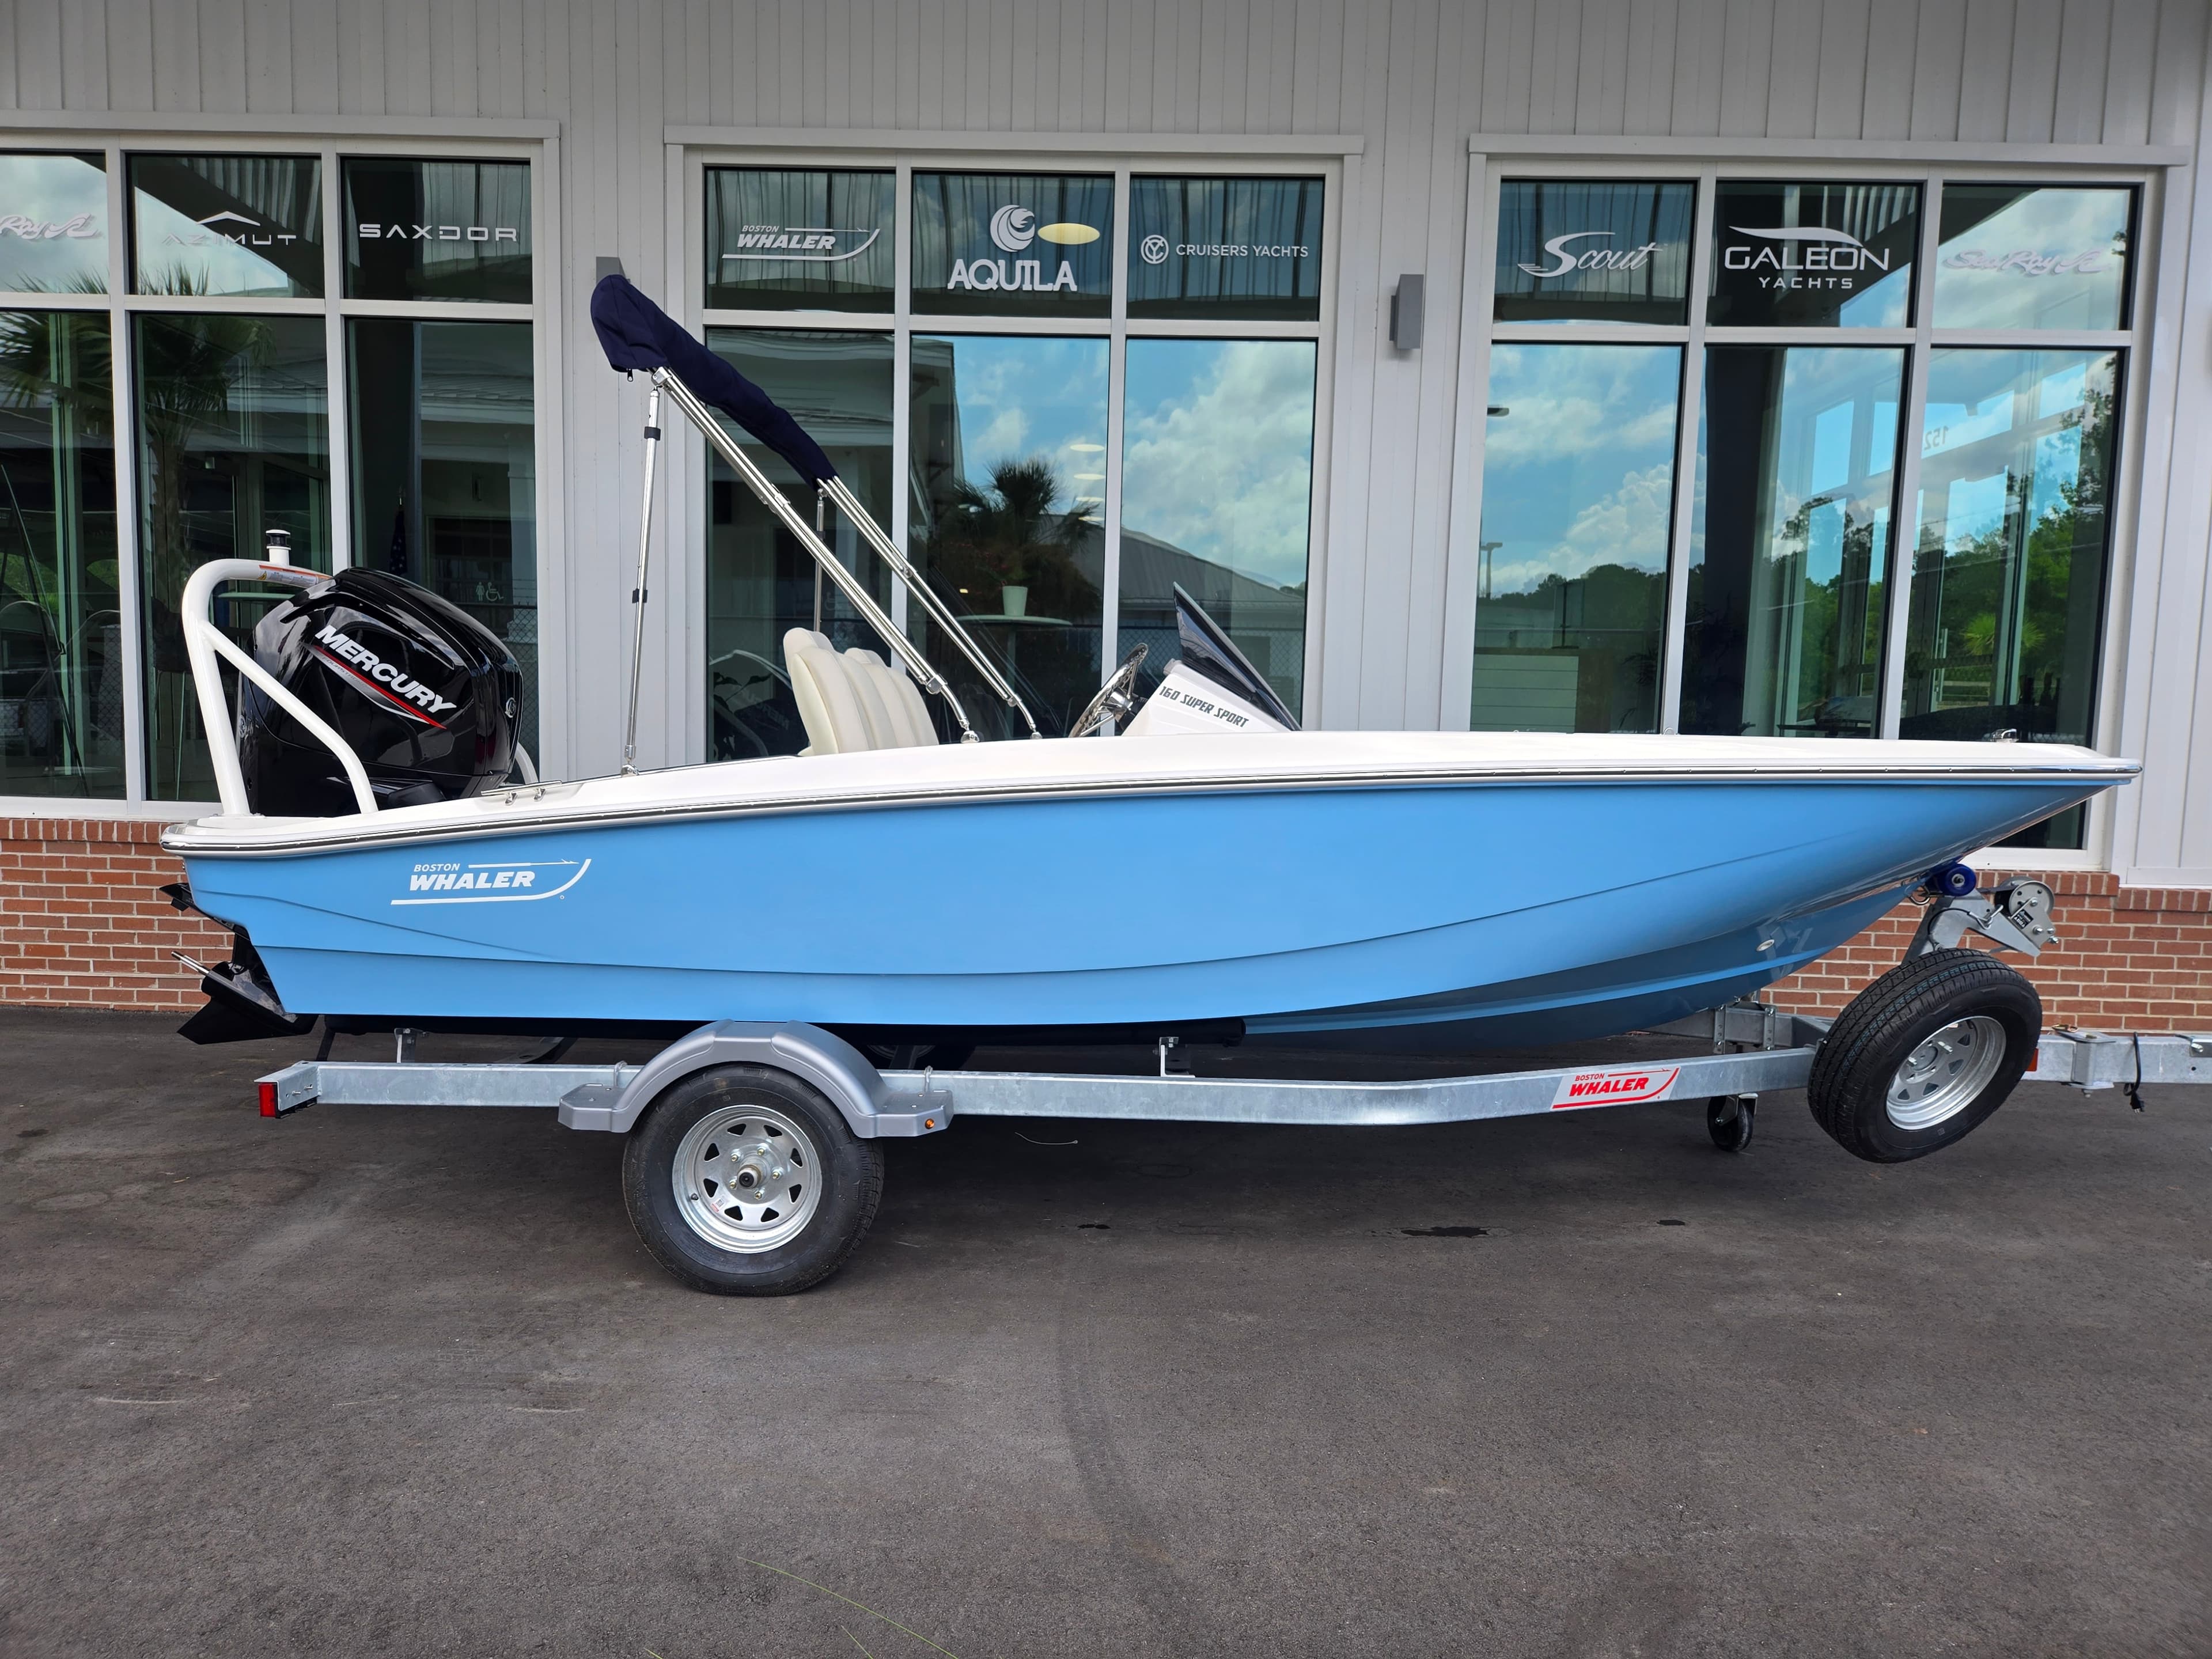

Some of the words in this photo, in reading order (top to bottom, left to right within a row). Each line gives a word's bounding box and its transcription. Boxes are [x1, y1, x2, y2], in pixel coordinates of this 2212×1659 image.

[162, 233, 297, 246] AZIMUT
[359, 224, 517, 242] SAXDOR
[737, 234, 835, 249] WHALER
[1176, 244, 1248, 256] CRUISERS
[1252, 245, 1308, 257] YACHTS
[1518, 232, 1663, 278] Scout
[1725, 247, 1889, 270] GALEON
[947, 259, 1077, 291] AQUILA
[1759, 277, 1853, 289] YACHTS
[315, 625, 457, 713] MERCURY
[1159, 685, 1181, 700] 160
[1180, 694, 1214, 714] SUPER
[1214, 708, 1249, 728] SPORT
[414, 863, 460, 872] BOSTON
[410, 871, 535, 891] WHALER
[1575, 1073, 1605, 1081] BOSTON
[1569, 1077, 1649, 1097] WHALER
